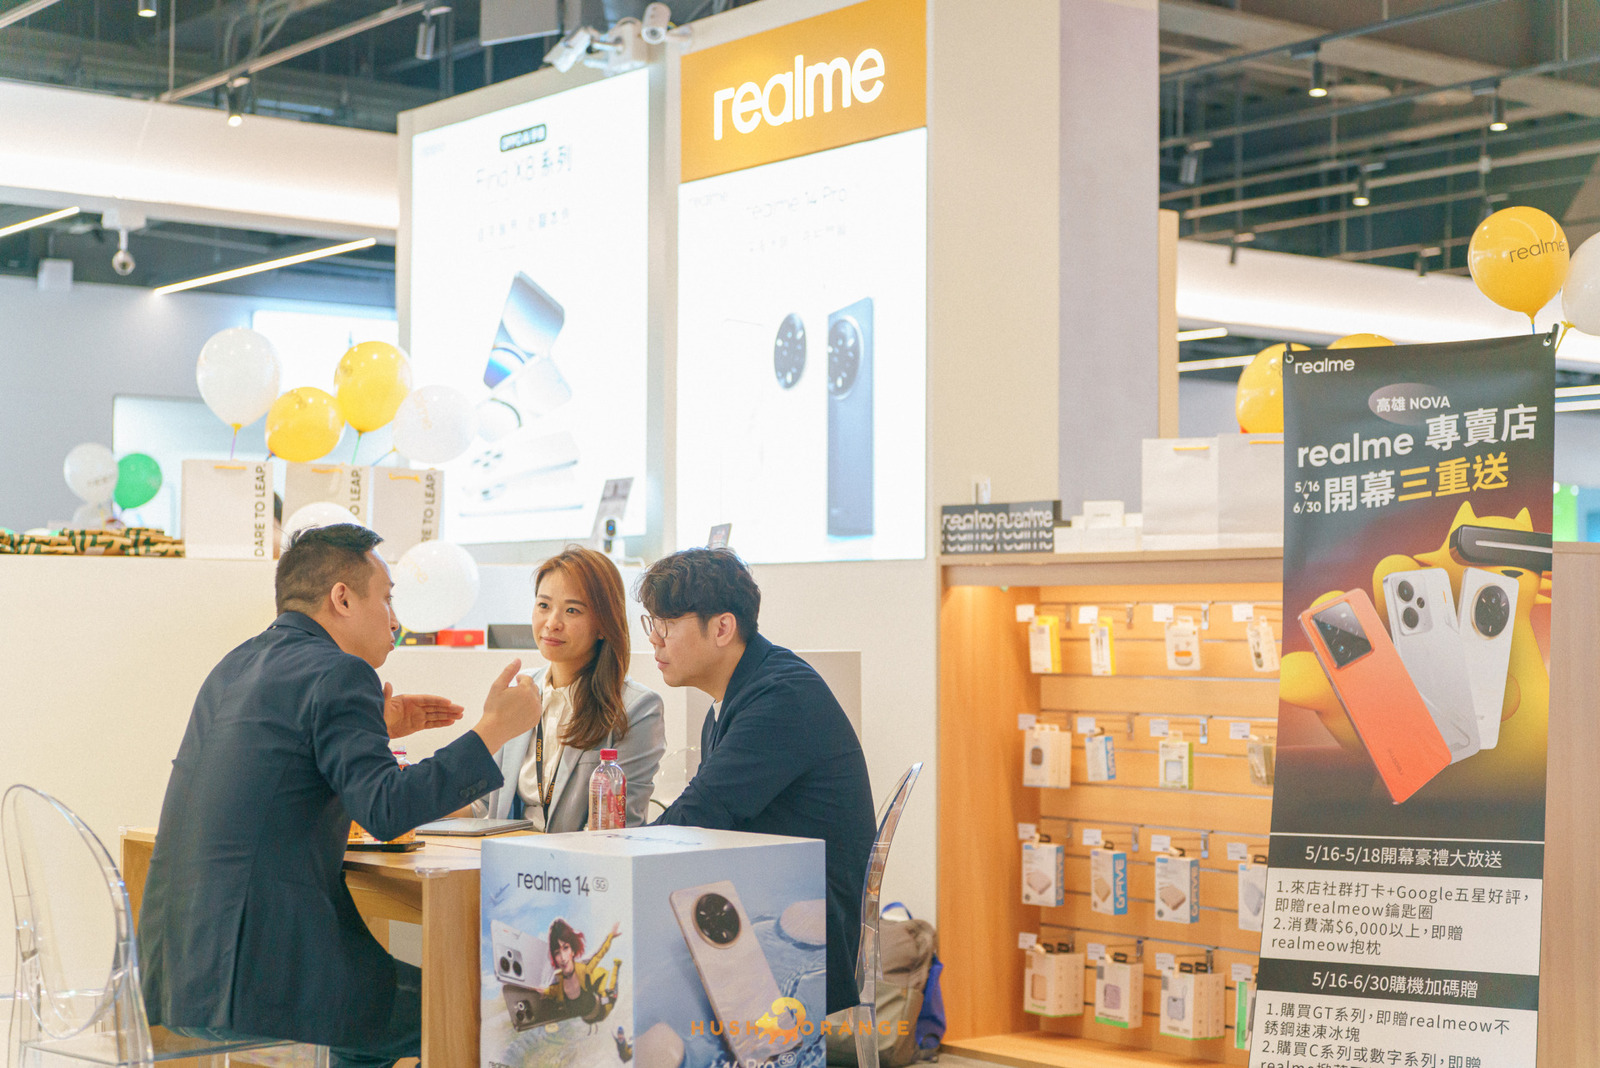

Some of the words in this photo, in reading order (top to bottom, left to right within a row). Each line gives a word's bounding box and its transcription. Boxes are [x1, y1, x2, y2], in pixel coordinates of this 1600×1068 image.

[714, 48, 885, 141] realme
[1509, 239, 1566, 263] realme
[1294, 357, 1355, 374] realme
[1376, 396, 1406, 413] 高雄
[1409, 395, 1451, 411] NOVA
[1297, 432, 1414, 468] realme
[1424, 403, 1538, 452] 專賣店
[1294, 480, 1320, 494] 5/16
[1325, 451, 1509, 514] 開幕三重送
[254, 501, 265, 521] TO
[422, 504, 435, 524] TO
[1293, 500, 1322, 515] 6/30
[254, 524, 266, 557] DARE
[1304, 845, 1502, 869] 5/16-5/18開幕豪禮大放送
[517, 870, 572, 895] realme
[575, 875, 590, 897] 14
[1275, 898, 1433, 921] 即贈realmeow鑰匙圈
[1271, 936, 1381, 956] realmeow抱枕
[1311, 971, 1478, 999] 5/16-6/30購機加碼贈
